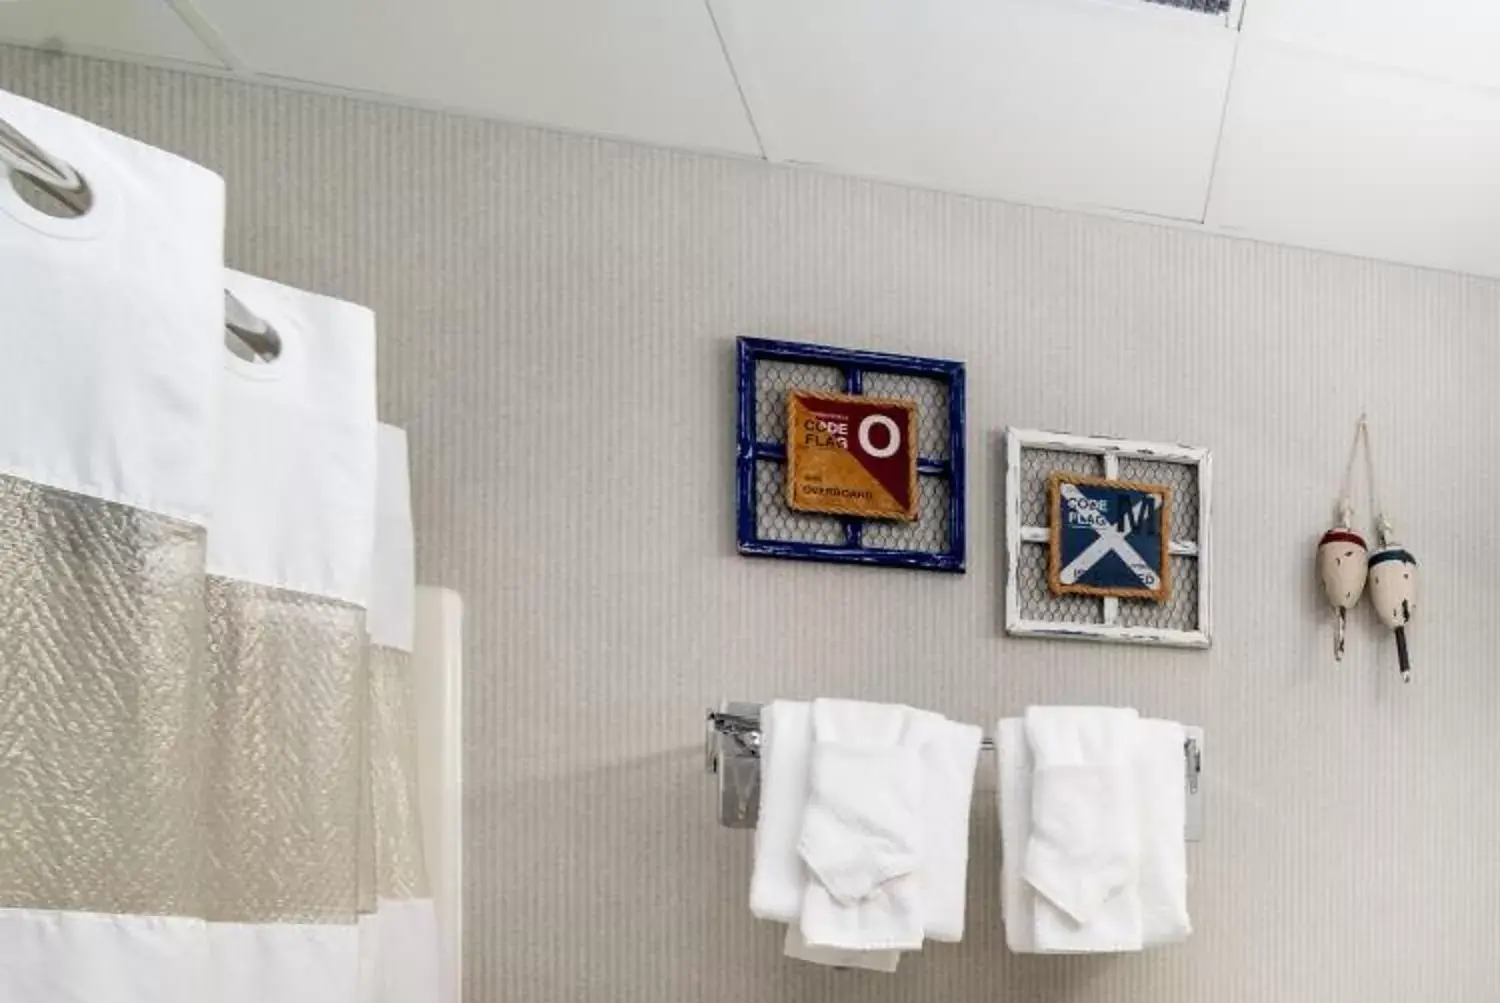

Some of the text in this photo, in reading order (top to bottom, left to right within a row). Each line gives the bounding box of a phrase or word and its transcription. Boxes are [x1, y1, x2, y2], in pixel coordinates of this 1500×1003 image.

[803, 418, 848, 435] CODE
[804, 433, 848, 449] FLAG
[858, 413, 900, 458] O
[1067, 497, 1108, 512] CODE
[1068, 511, 1107, 525] FLAG
[1117, 494, 1156, 536] M
